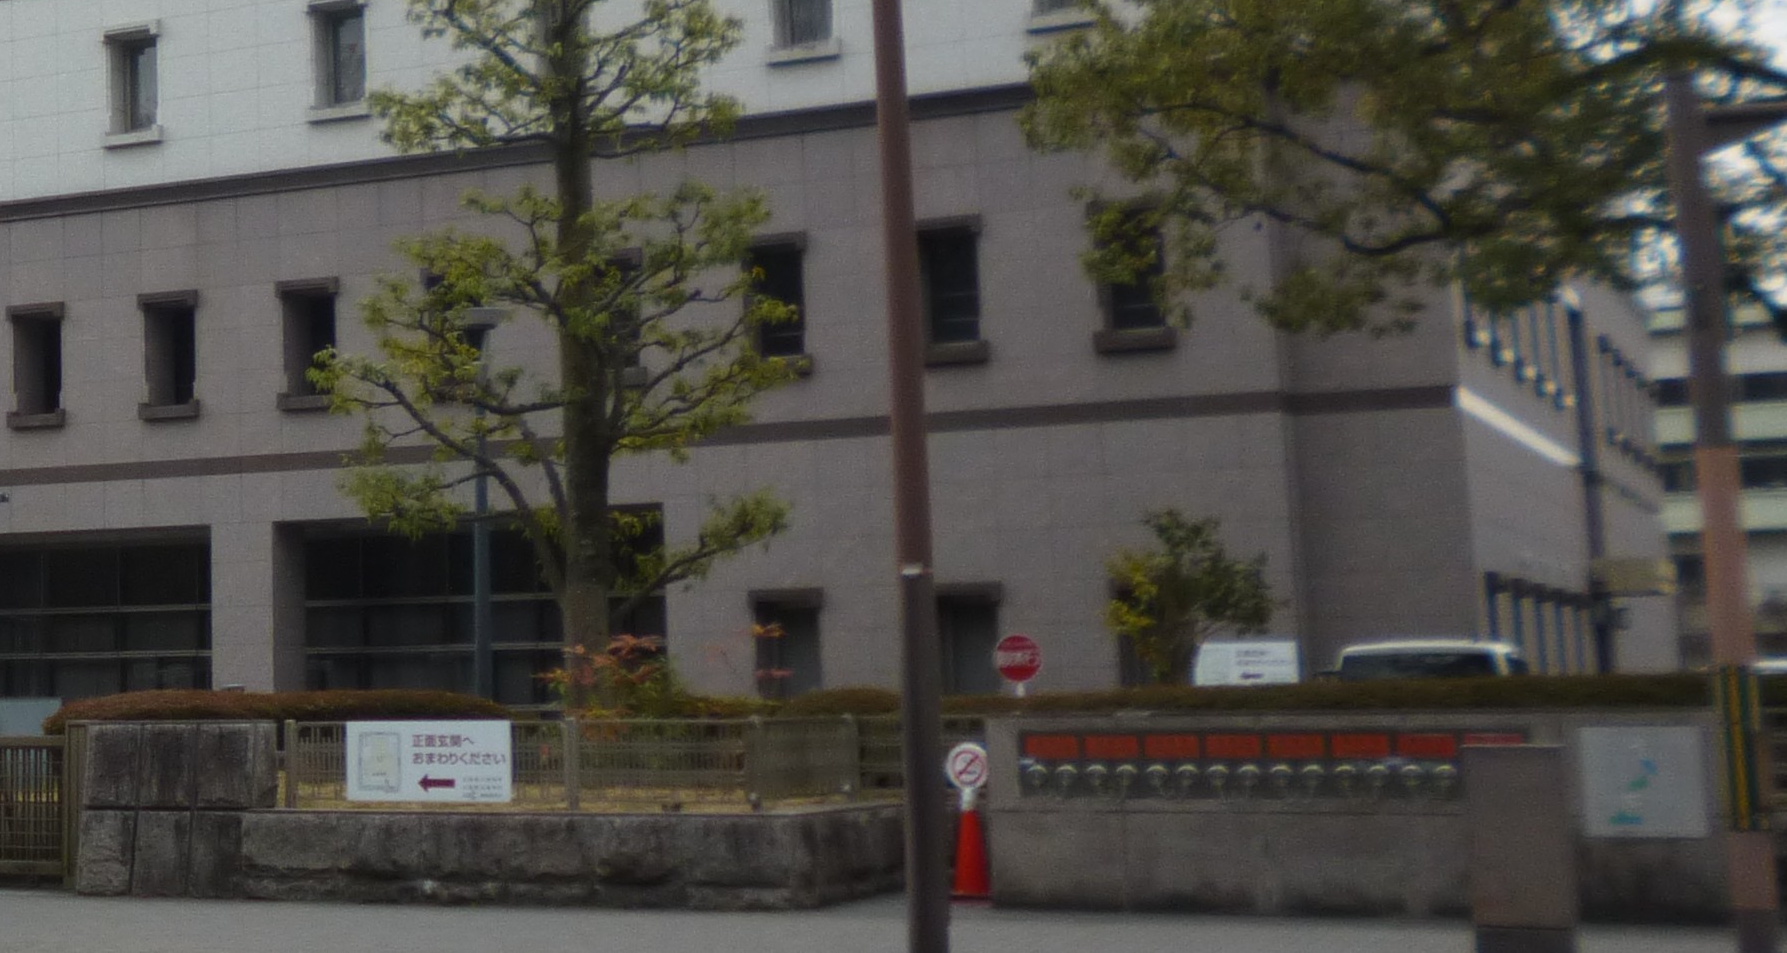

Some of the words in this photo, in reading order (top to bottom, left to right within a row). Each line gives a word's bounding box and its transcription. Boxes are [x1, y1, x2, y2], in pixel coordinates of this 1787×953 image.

[412, 734, 474, 748] 正面玄関へ
[412, 752, 506, 765] おまわりください
